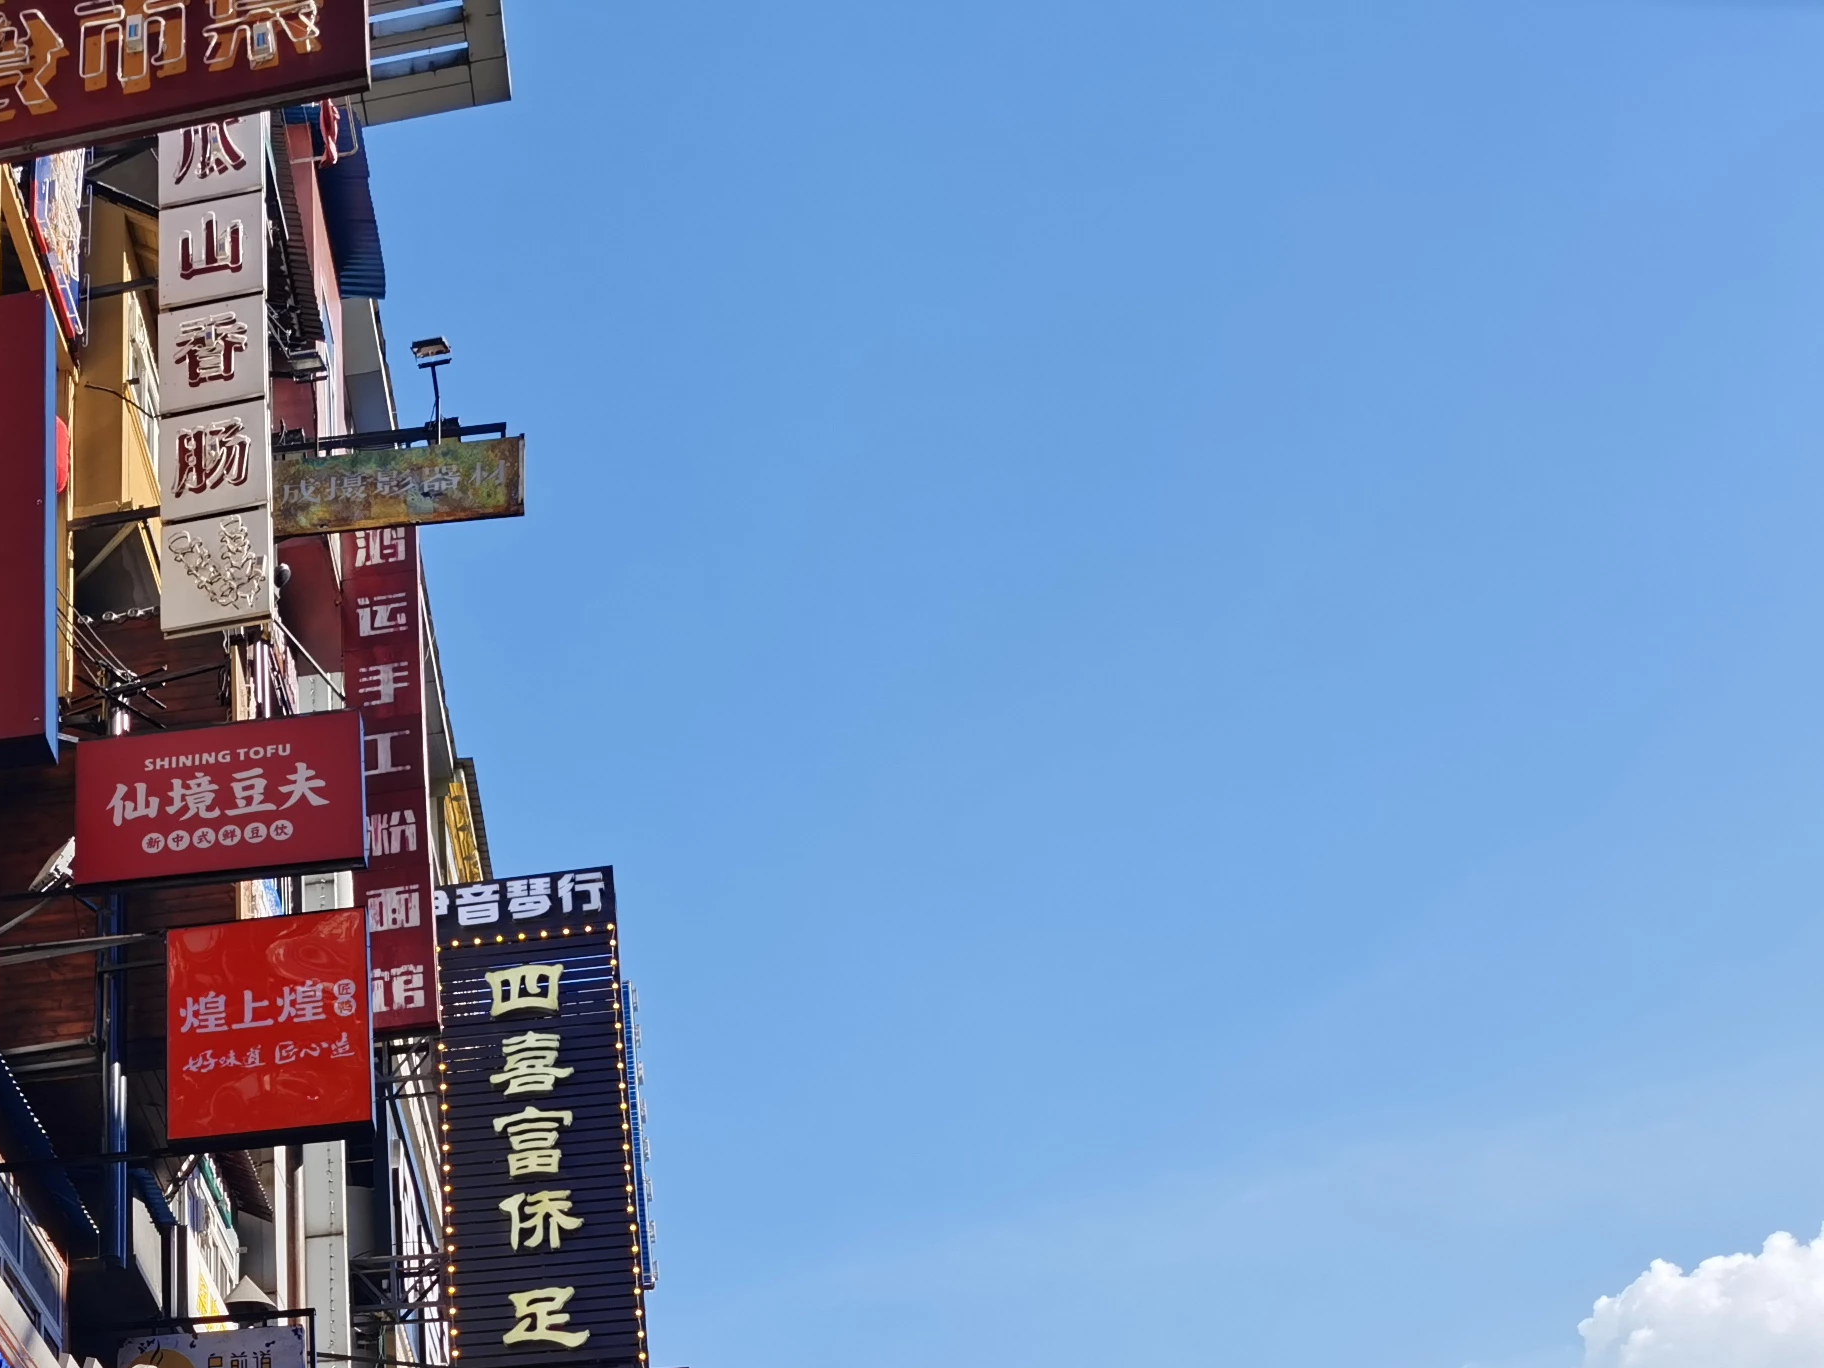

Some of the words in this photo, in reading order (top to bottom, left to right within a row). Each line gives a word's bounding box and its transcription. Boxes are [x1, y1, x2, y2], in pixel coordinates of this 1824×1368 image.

[144, 749, 231, 771] SHINING
[236, 743, 292, 760] TOFU
[107, 760, 330, 827] 仙境豆夫
[141, 819, 294, 854] 新中式鲜豆饮
[179, 979, 326, 1034] 煌上煌
